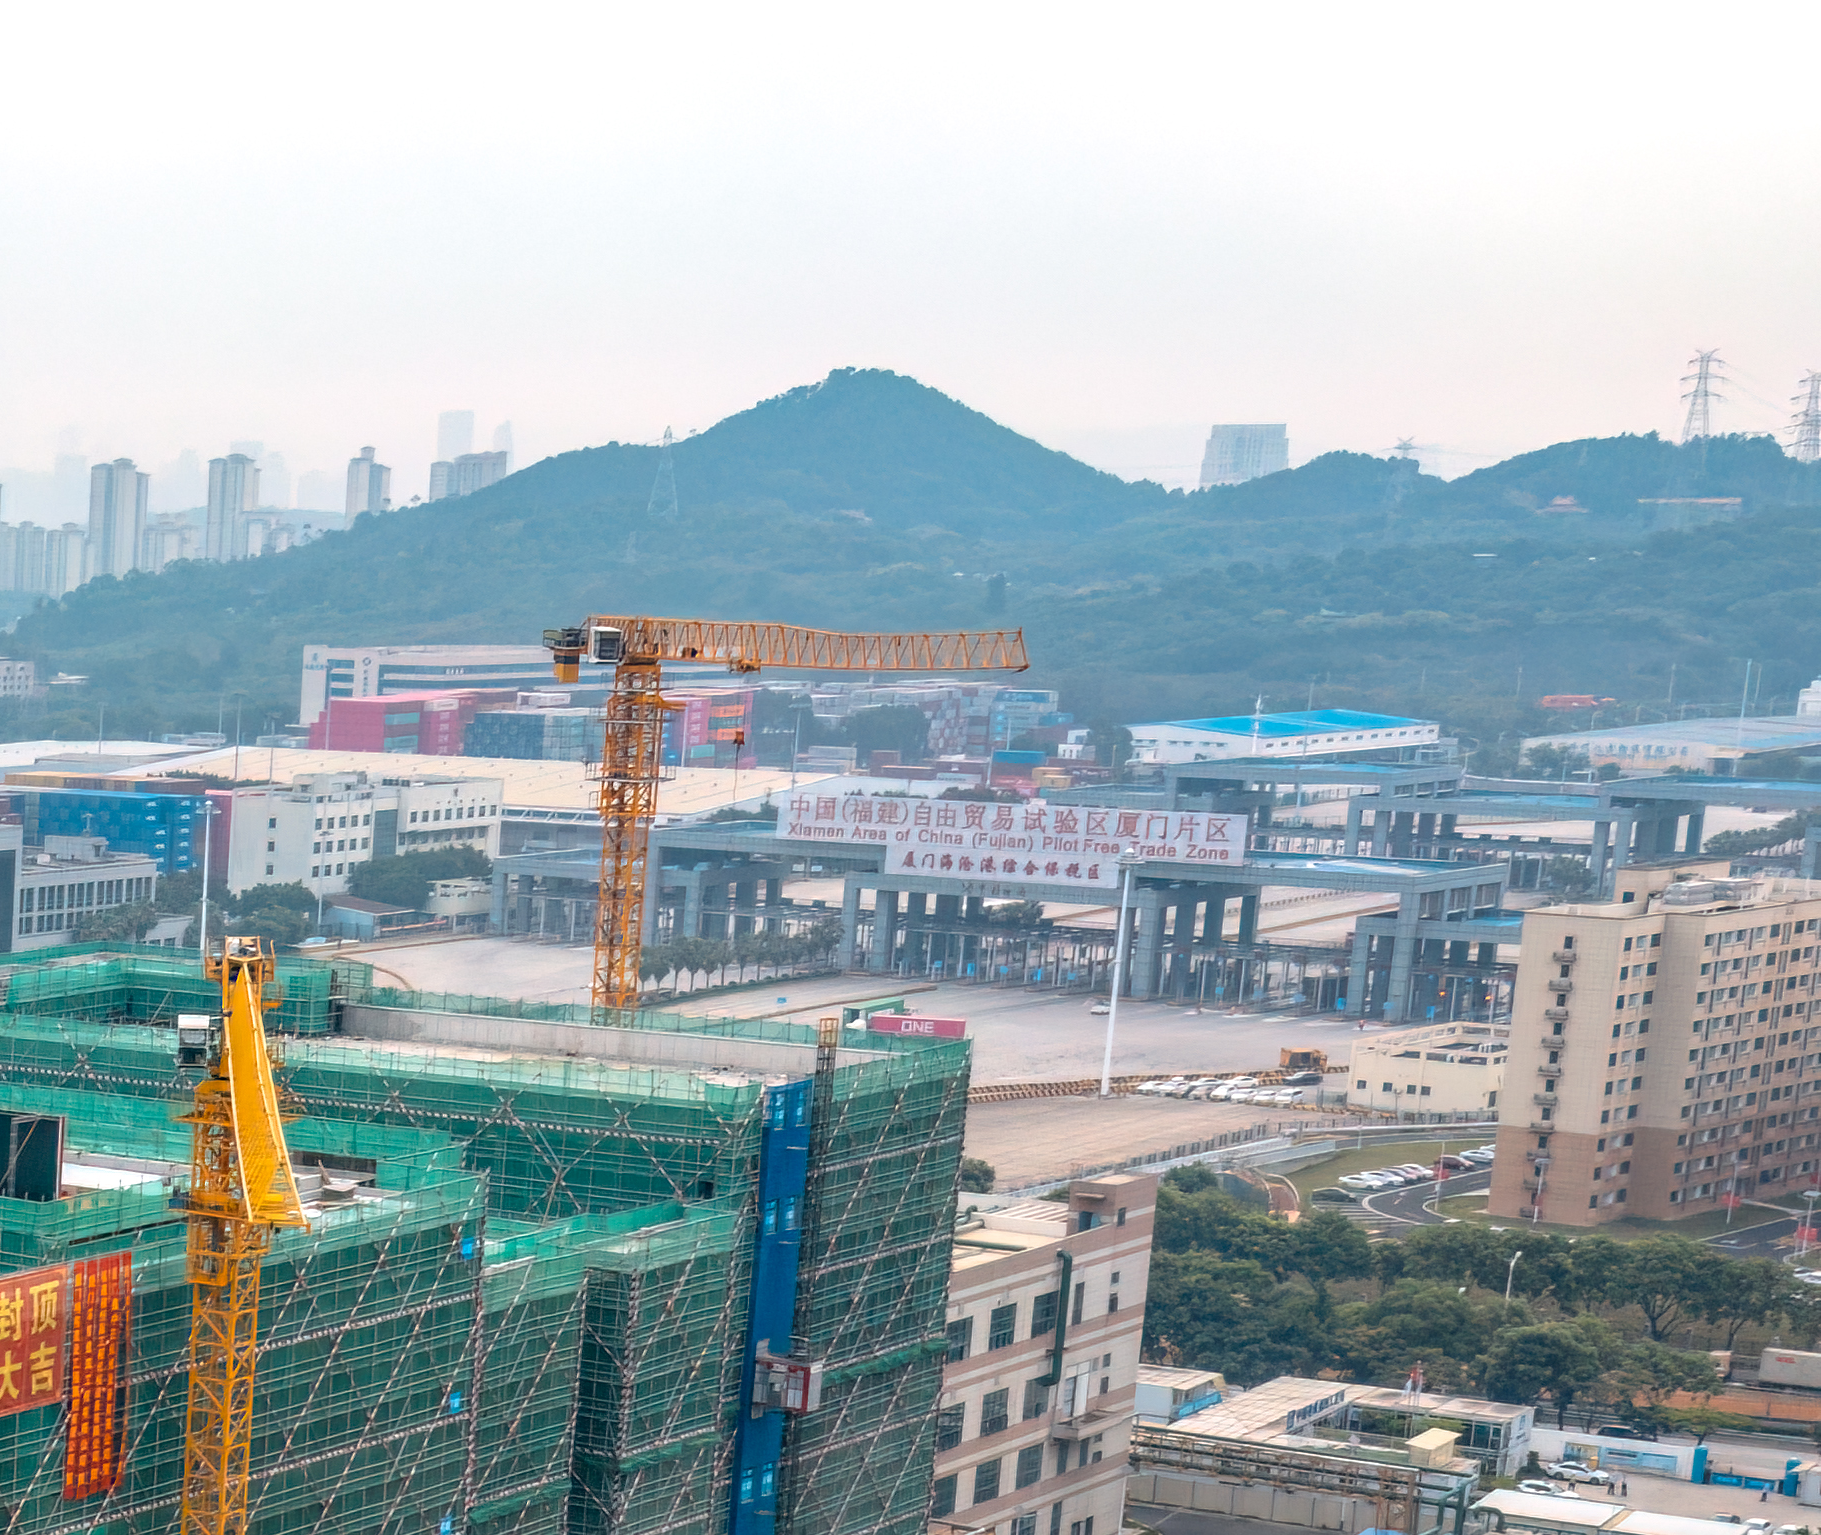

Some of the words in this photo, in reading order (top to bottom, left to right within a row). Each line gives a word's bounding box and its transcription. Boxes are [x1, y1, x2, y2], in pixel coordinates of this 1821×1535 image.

[790, 794, 1232, 842] 中国(福建)自由贸易试验区厦门片区
[788, 822, 844, 838] Xiamen
[851, 826, 887, 841] Area
[895, 828, 911, 842] of
[918, 829, 963, 845] China
[972, 832, 1034, 851] (Fujian)
[1042, 836, 1078, 852] Pilot
[1083, 838, 1120, 854] Free
[1130, 841, 1177, 858] Trade
[1185, 843, 1230, 860] Zone
[900, 1020, 934, 1033] ONE
